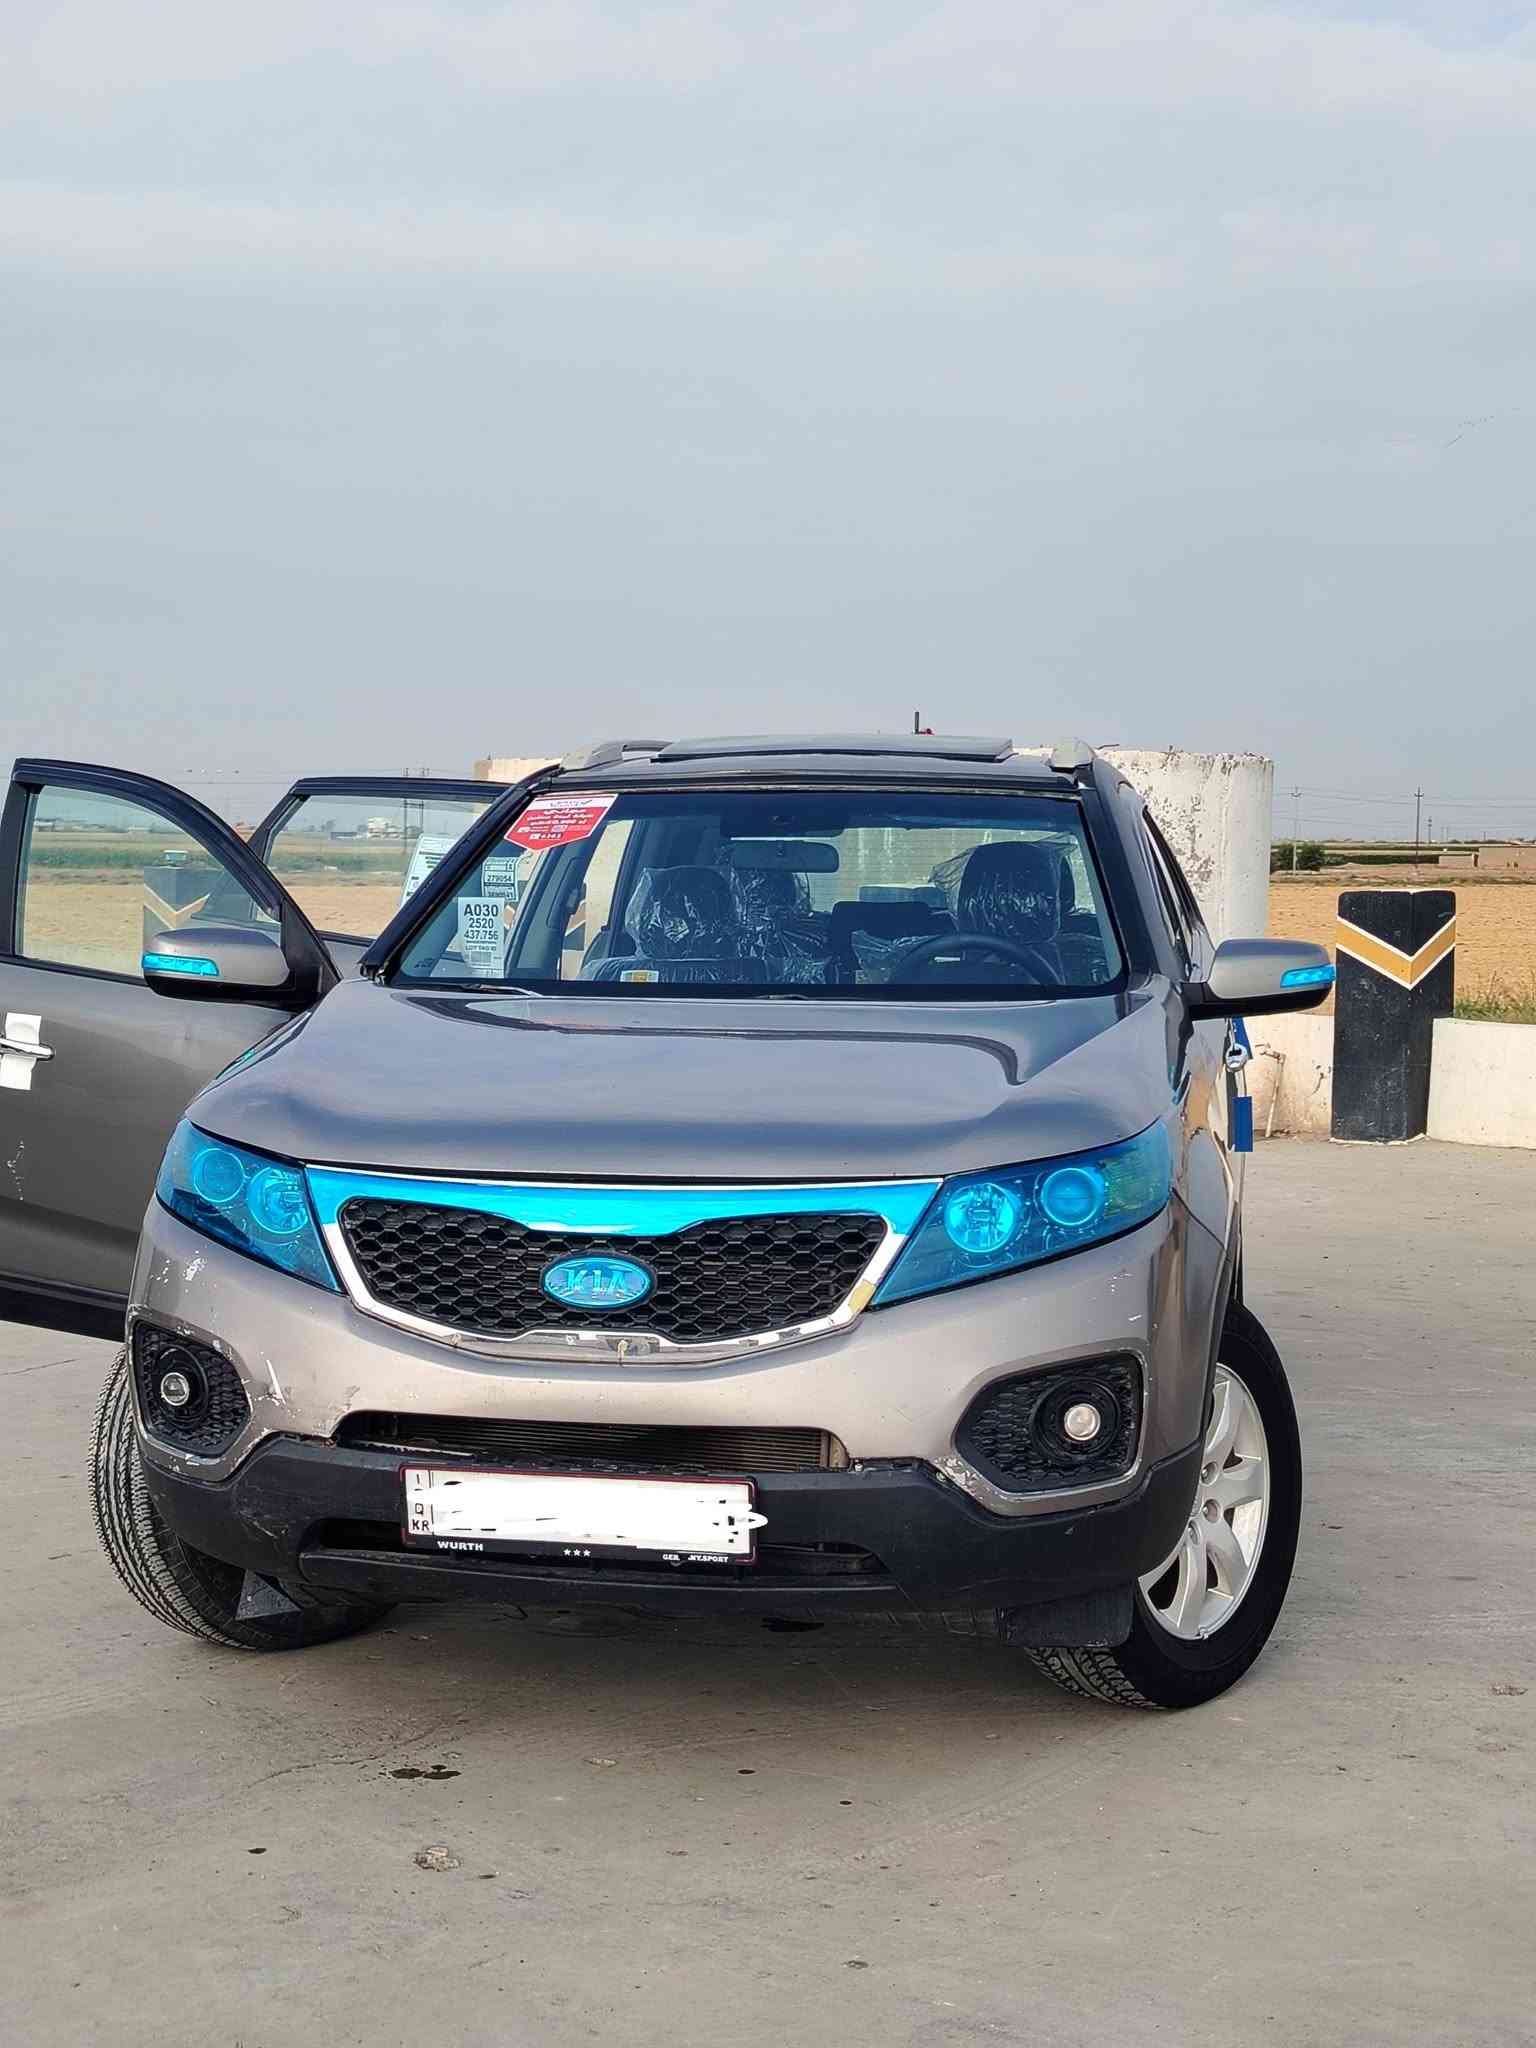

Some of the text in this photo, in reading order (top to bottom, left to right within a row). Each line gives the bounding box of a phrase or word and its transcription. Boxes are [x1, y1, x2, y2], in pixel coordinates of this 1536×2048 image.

[464, 904, 499, 917] A030
[468, 918, 494, 929] 2520
[562, 1268, 628, 1296] KIA
[412, 1519, 430, 1531] KR
[437, 1541, 484, 1551] WURTH
